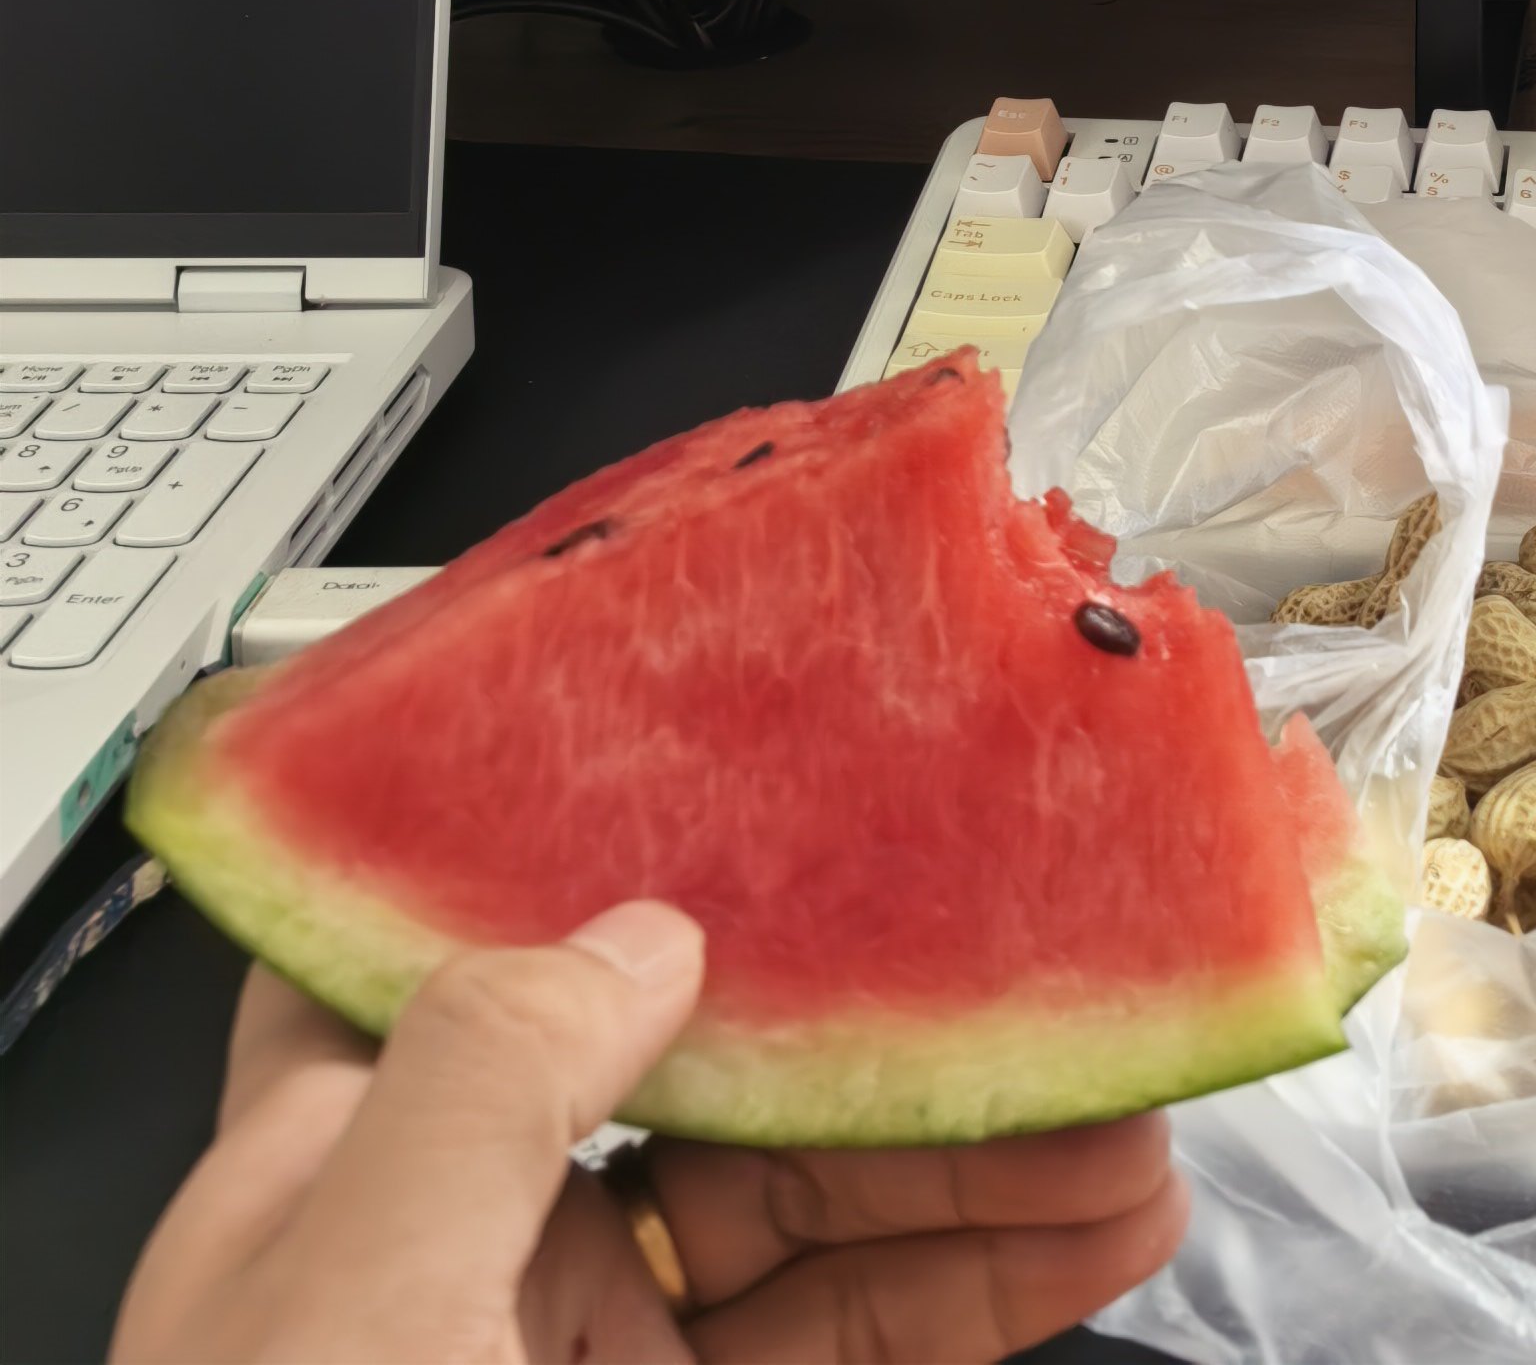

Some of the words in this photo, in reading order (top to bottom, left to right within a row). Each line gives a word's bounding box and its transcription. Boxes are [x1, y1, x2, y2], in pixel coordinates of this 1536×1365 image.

[1171, 115, 1188, 124] F1
[1260, 118, 1280, 127] F2
[1348, 120, 1368, 129] F3
[1436, 121, 1456, 130] F4
[1519, 189, 1532, 199] 6
[954, 228, 984, 239] Tab
[931, 290, 974, 301] Caps
[979, 293, 1022, 303] Lock
[112, 365, 142, 373] End
[190, 365, 229, 374] PgUp
[272, 365, 311, 374] PgDn
[17, 444, 41, 458] 8
[106, 445, 129, 459] 9
[106, 464, 143, 475] PgUp
[60, 497, 84, 512] 6
[5, 552, 31, 568] 3
[5, 575, 44, 586] PgDn
[65, 593, 125, 605] Enter
